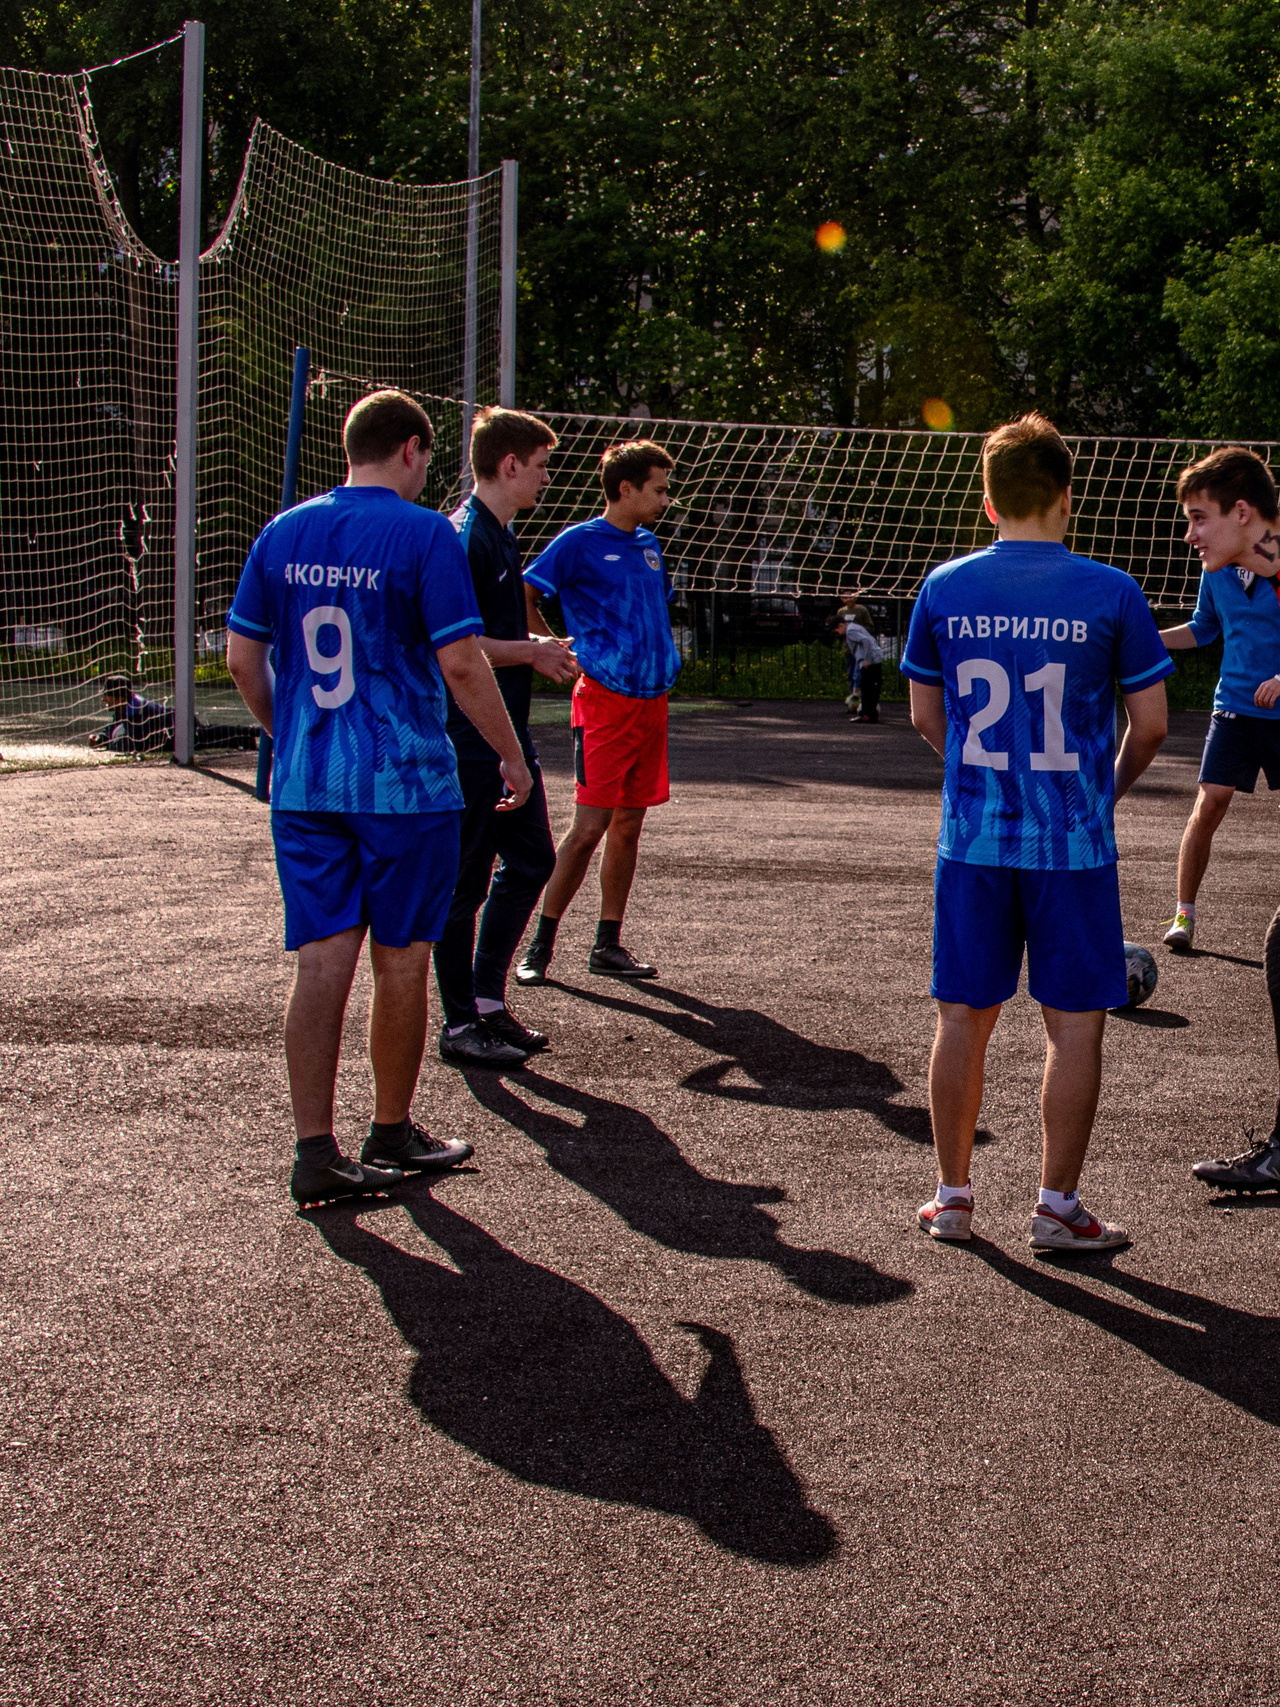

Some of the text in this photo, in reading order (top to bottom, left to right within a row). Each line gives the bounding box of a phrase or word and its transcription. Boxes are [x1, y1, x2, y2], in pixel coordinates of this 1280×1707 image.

[302, 605, 355, 709] 9
[948, 615, 1088, 643] ГАВРИЛОВ
[956, 658, 1080, 771] 21
